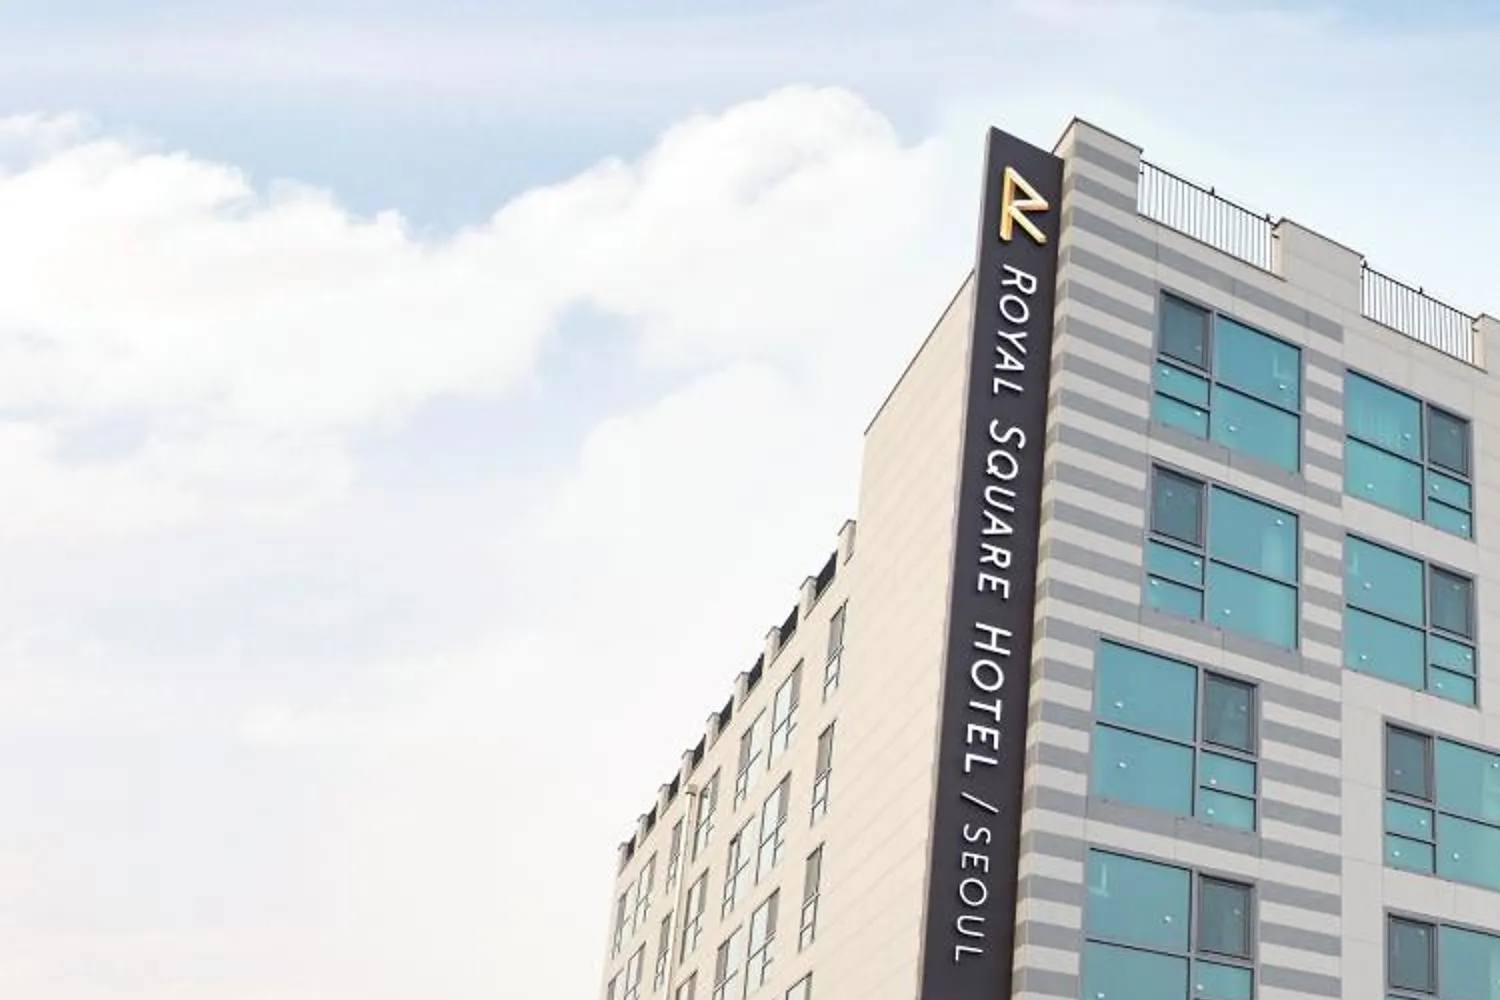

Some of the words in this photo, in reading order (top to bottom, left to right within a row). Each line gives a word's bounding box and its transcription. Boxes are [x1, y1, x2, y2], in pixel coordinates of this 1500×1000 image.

[992, 262, 1039, 395] ROYAL
[976, 417, 1028, 600] SQUARE
[964, 620, 1014, 774] HOTEL
[955, 822, 993, 962] SEOUL
